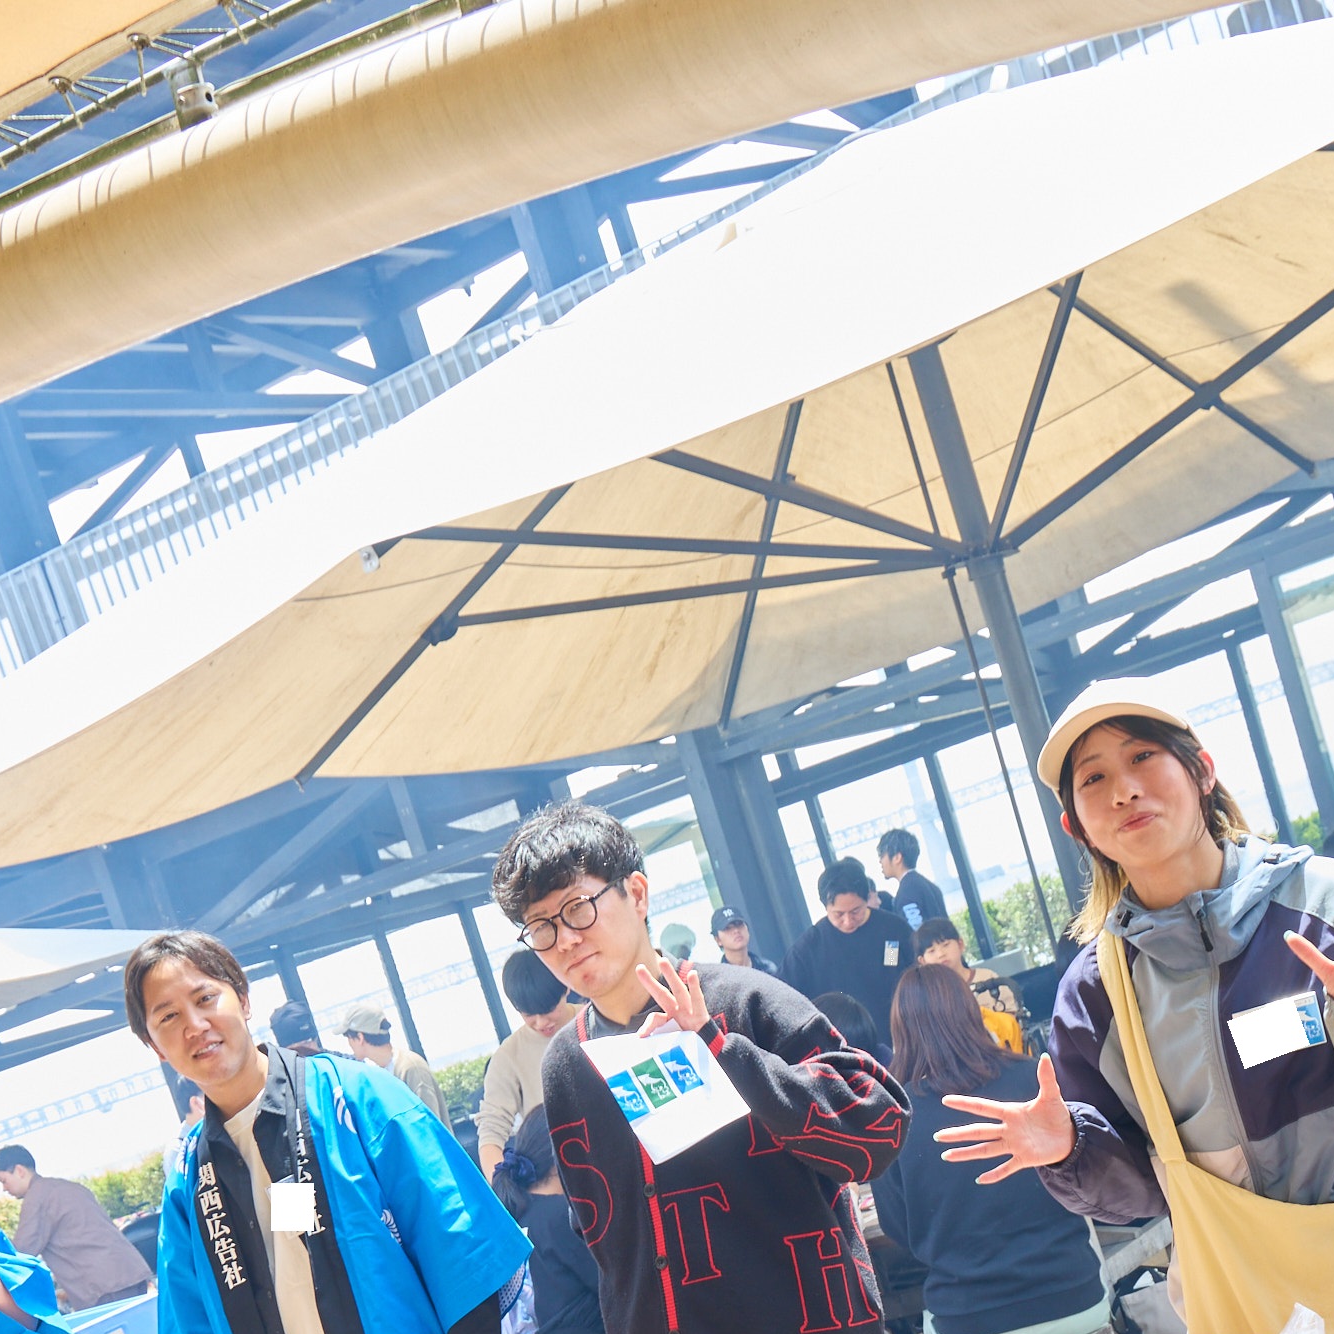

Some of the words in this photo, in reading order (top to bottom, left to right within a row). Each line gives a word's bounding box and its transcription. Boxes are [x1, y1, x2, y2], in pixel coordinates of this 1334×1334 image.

[198, 1162, 247, 1290] 関西広告社
